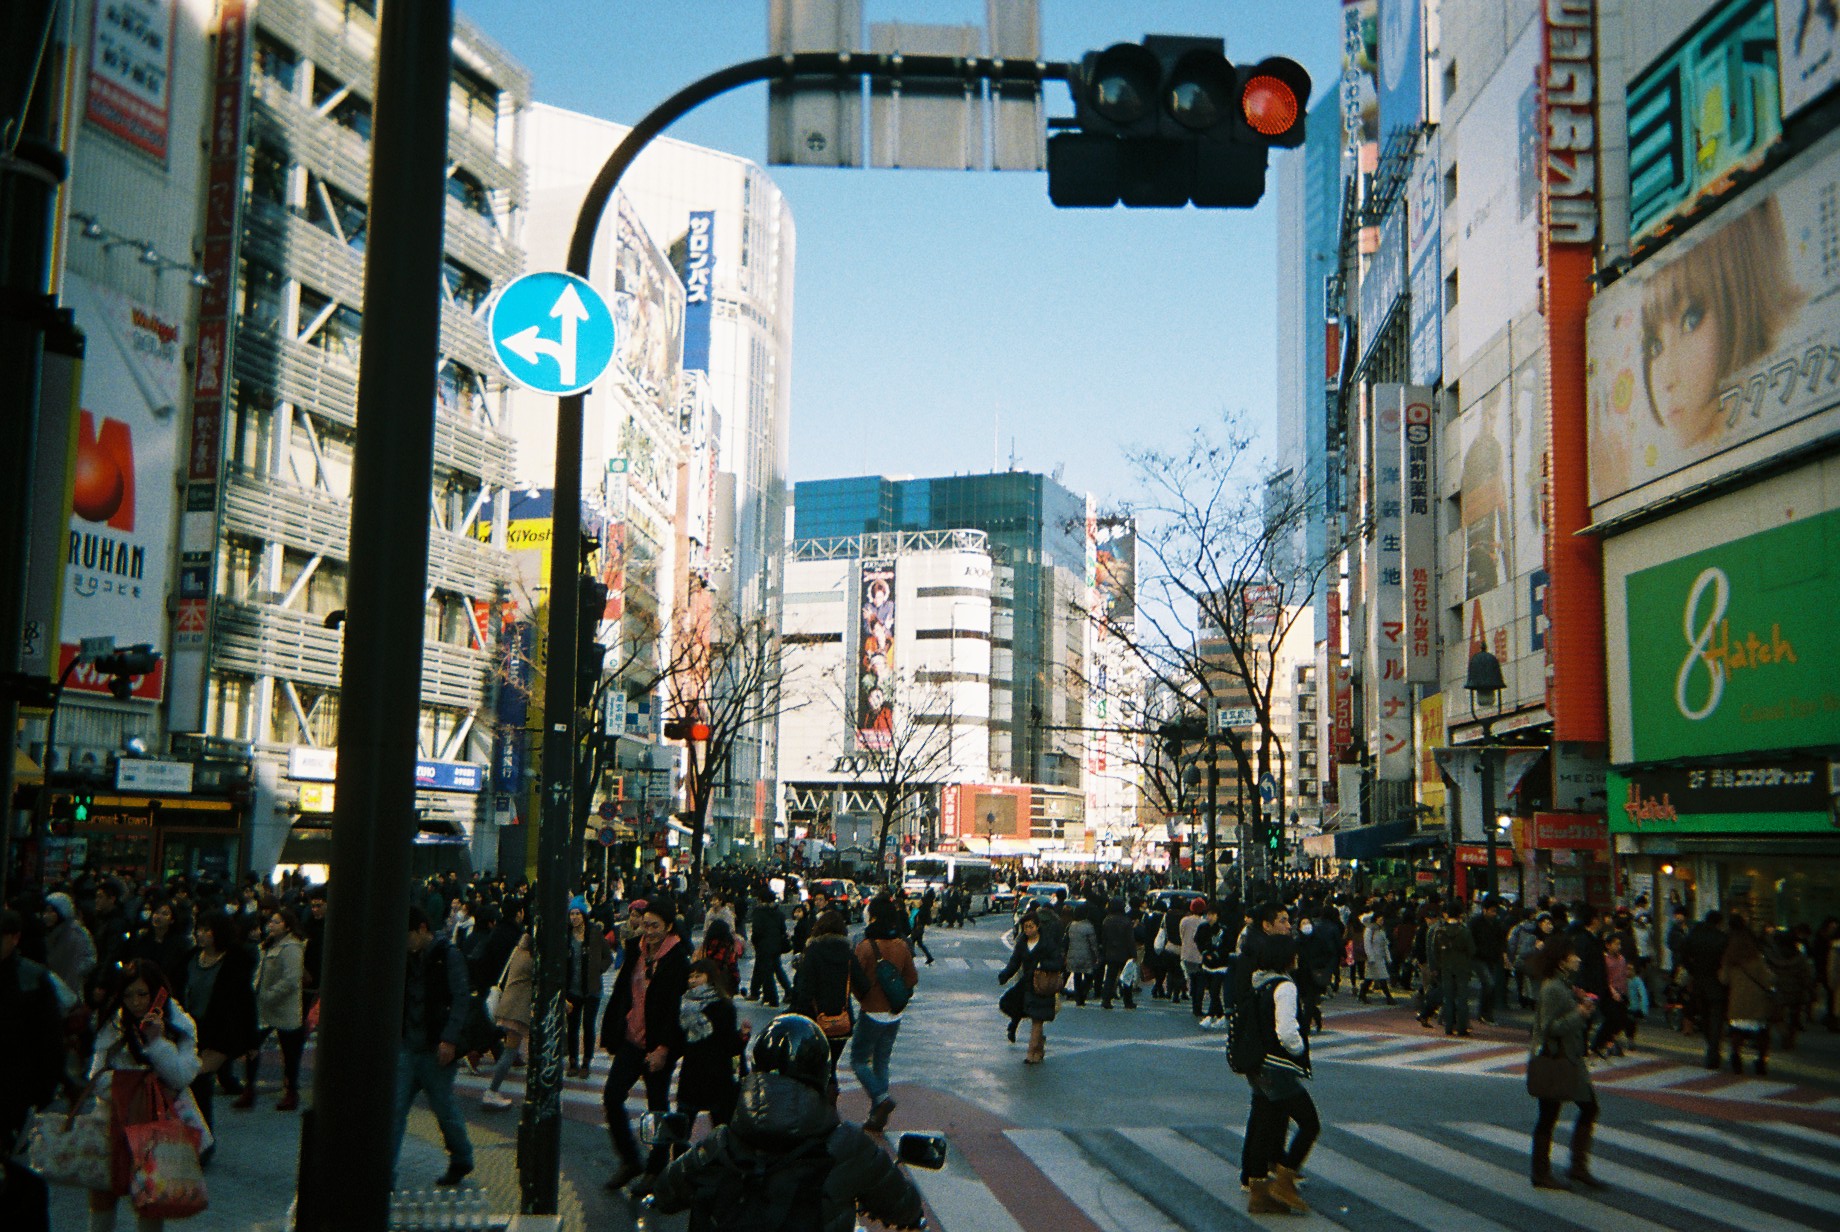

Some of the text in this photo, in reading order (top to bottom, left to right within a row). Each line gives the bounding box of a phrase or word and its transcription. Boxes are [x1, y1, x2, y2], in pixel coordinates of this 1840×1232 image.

[688, 217, 711, 303] サロンパス
[1409, 445, 1428, 515] 調剤薬局
[68, 530, 145, 580] RUHAN
[1412, 567, 1429, 657] 処方せん受付
[1703, 618, 1798, 682] Hatch
[1382, 621, 1406, 755] マルナン
[1624, 783, 1678, 828] Hatch
